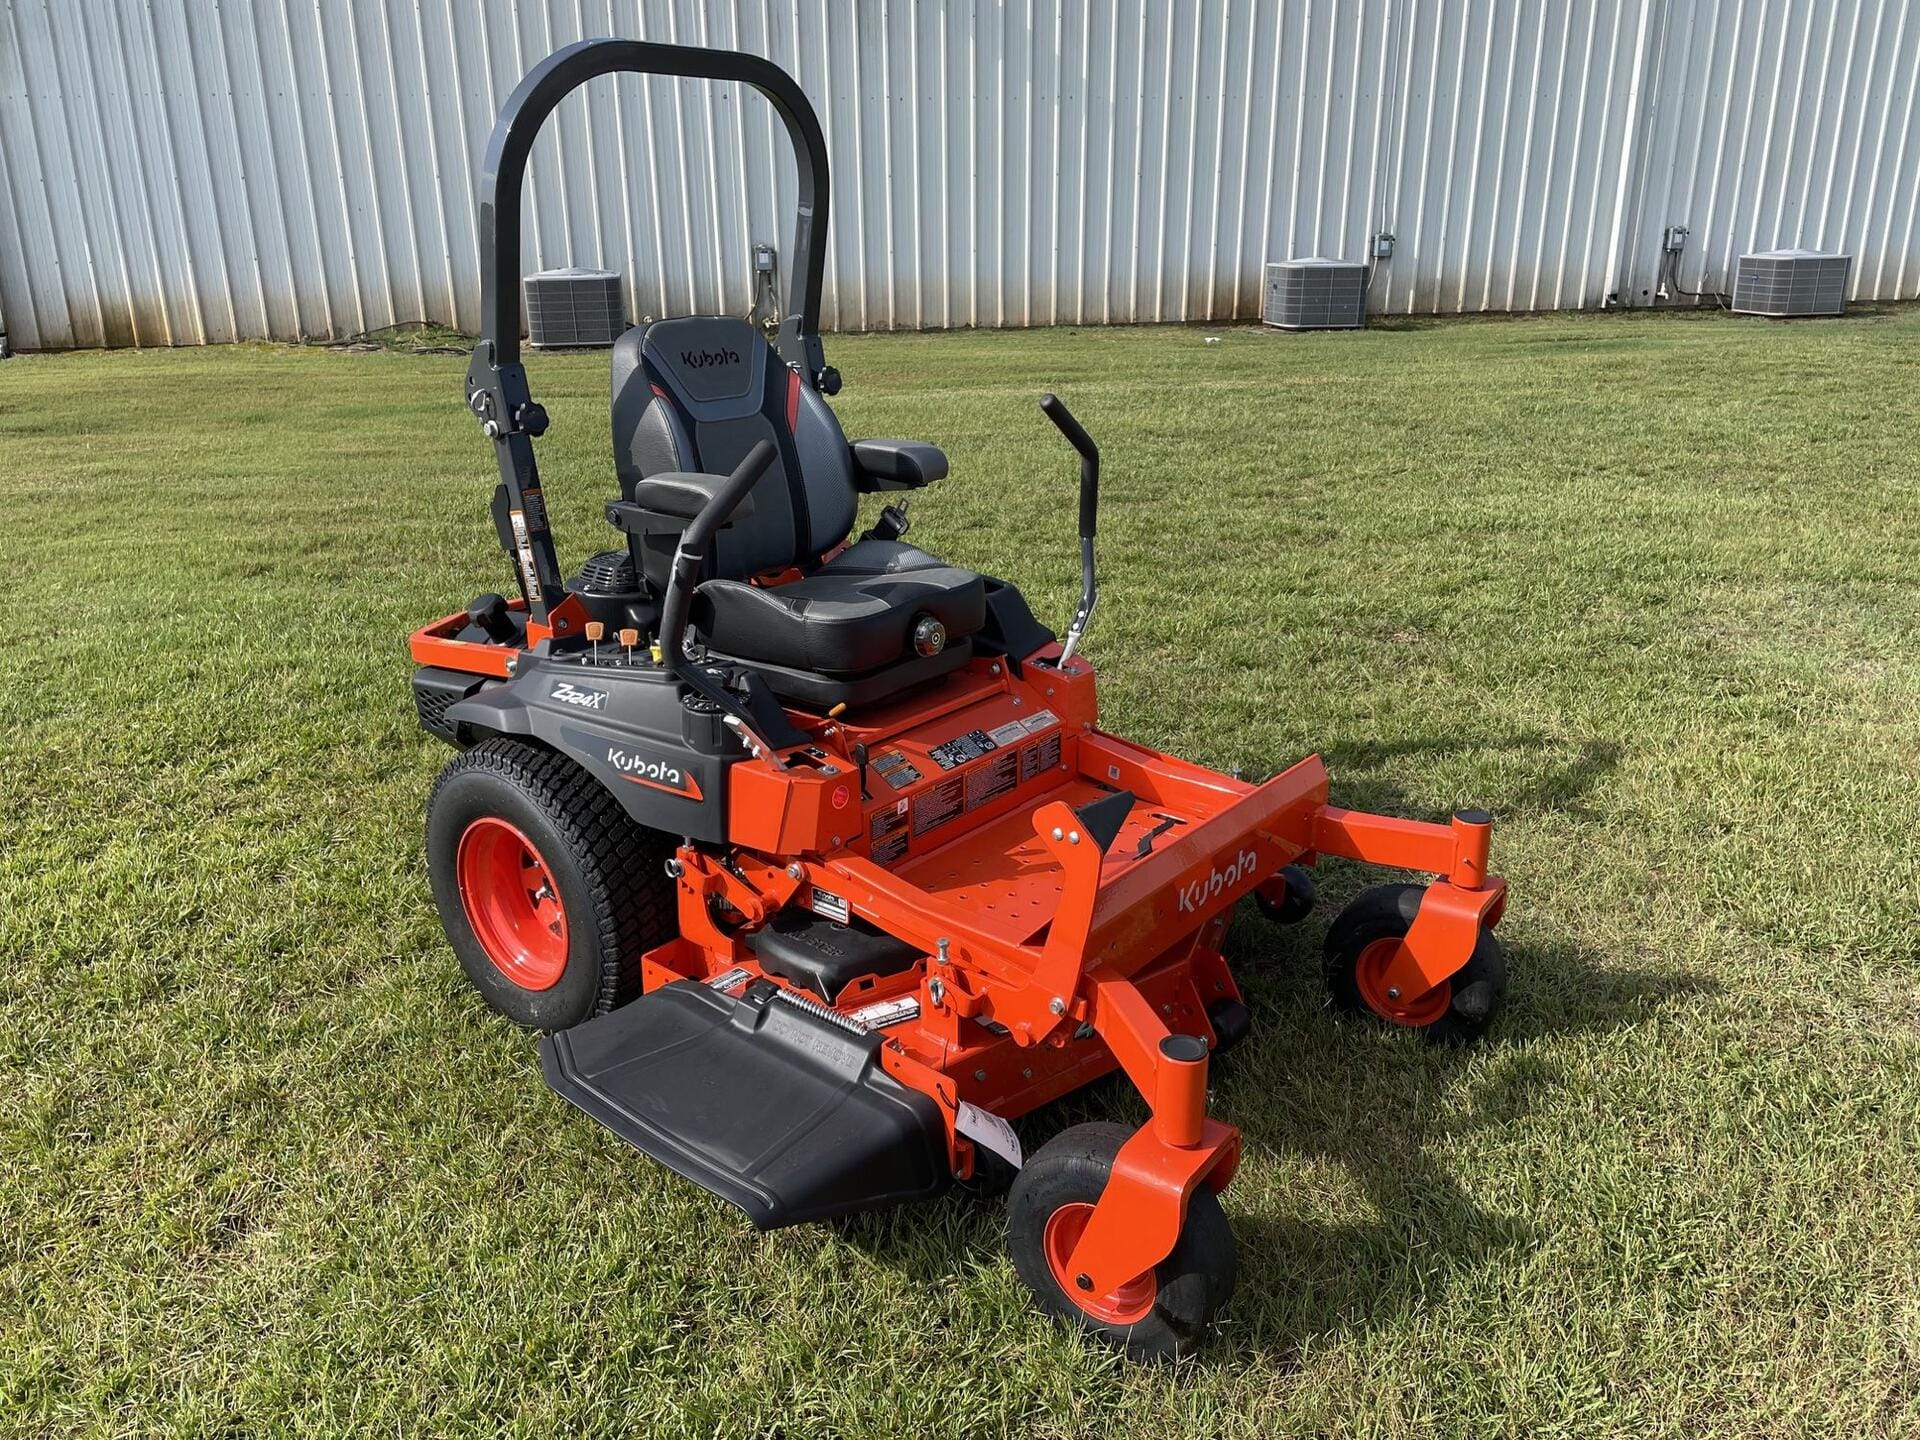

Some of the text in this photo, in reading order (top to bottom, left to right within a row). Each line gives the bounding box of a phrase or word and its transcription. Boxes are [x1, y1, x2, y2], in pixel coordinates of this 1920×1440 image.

[681, 347, 740, 369] Kubota
[607, 748, 680, 784] Kubota
[1179, 849, 1257, 913] Kubota
